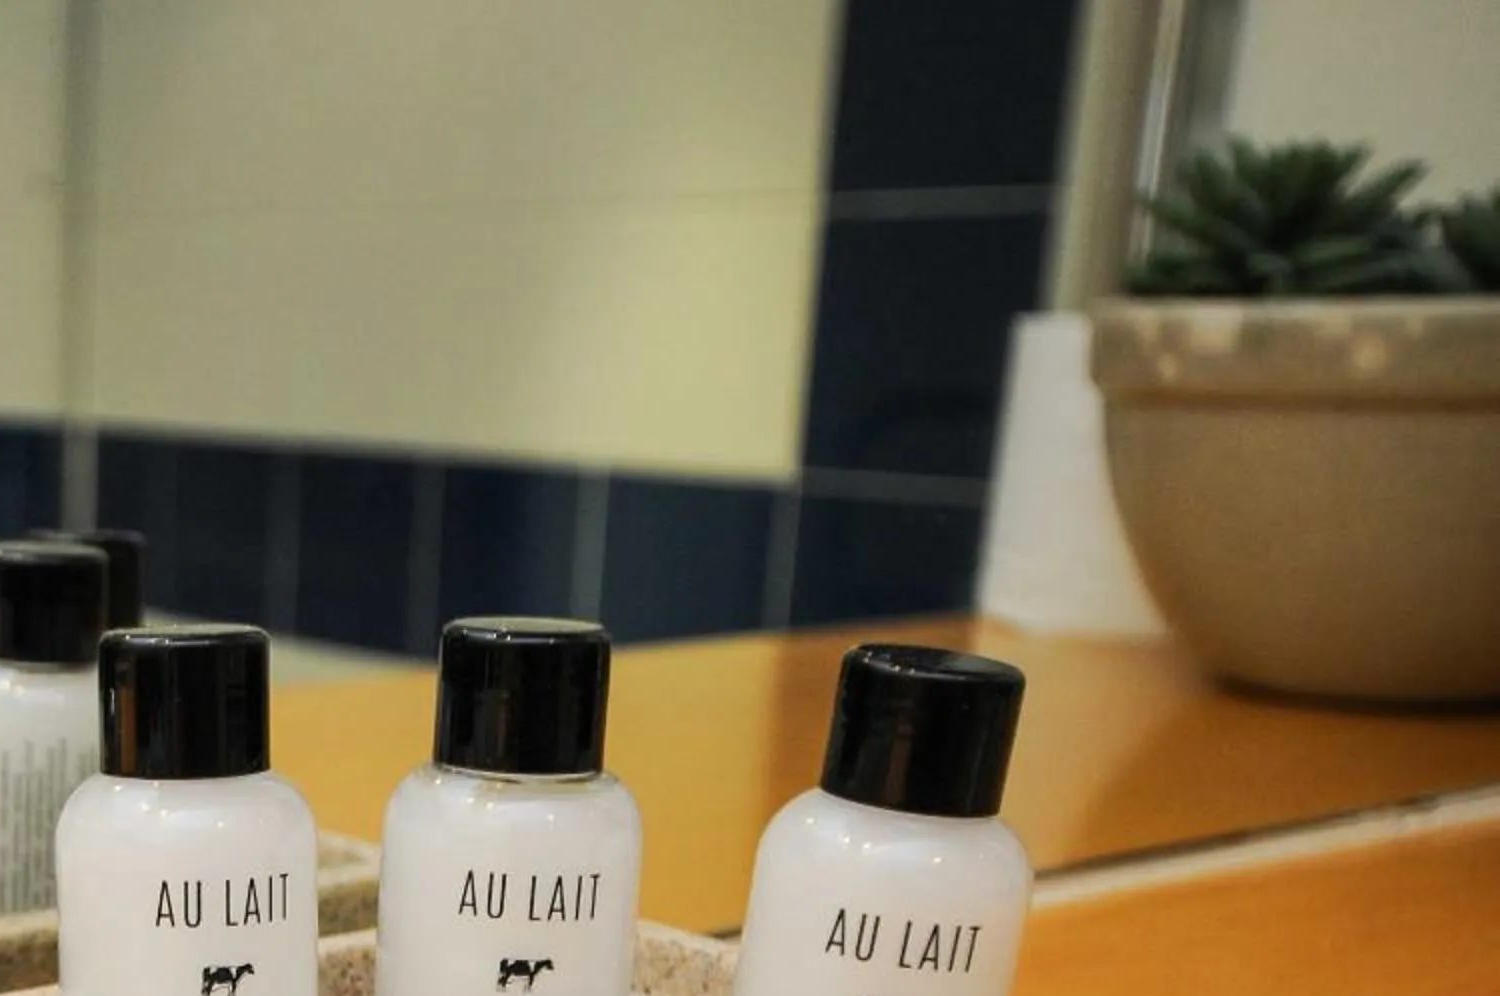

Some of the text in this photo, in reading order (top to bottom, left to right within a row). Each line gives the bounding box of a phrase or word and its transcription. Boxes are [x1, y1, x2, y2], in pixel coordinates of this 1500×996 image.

[156, 873, 288, 928] AU LAIT
[459, 870, 600, 921] AU LAIT
[825, 908, 981, 973] AU LAIT
